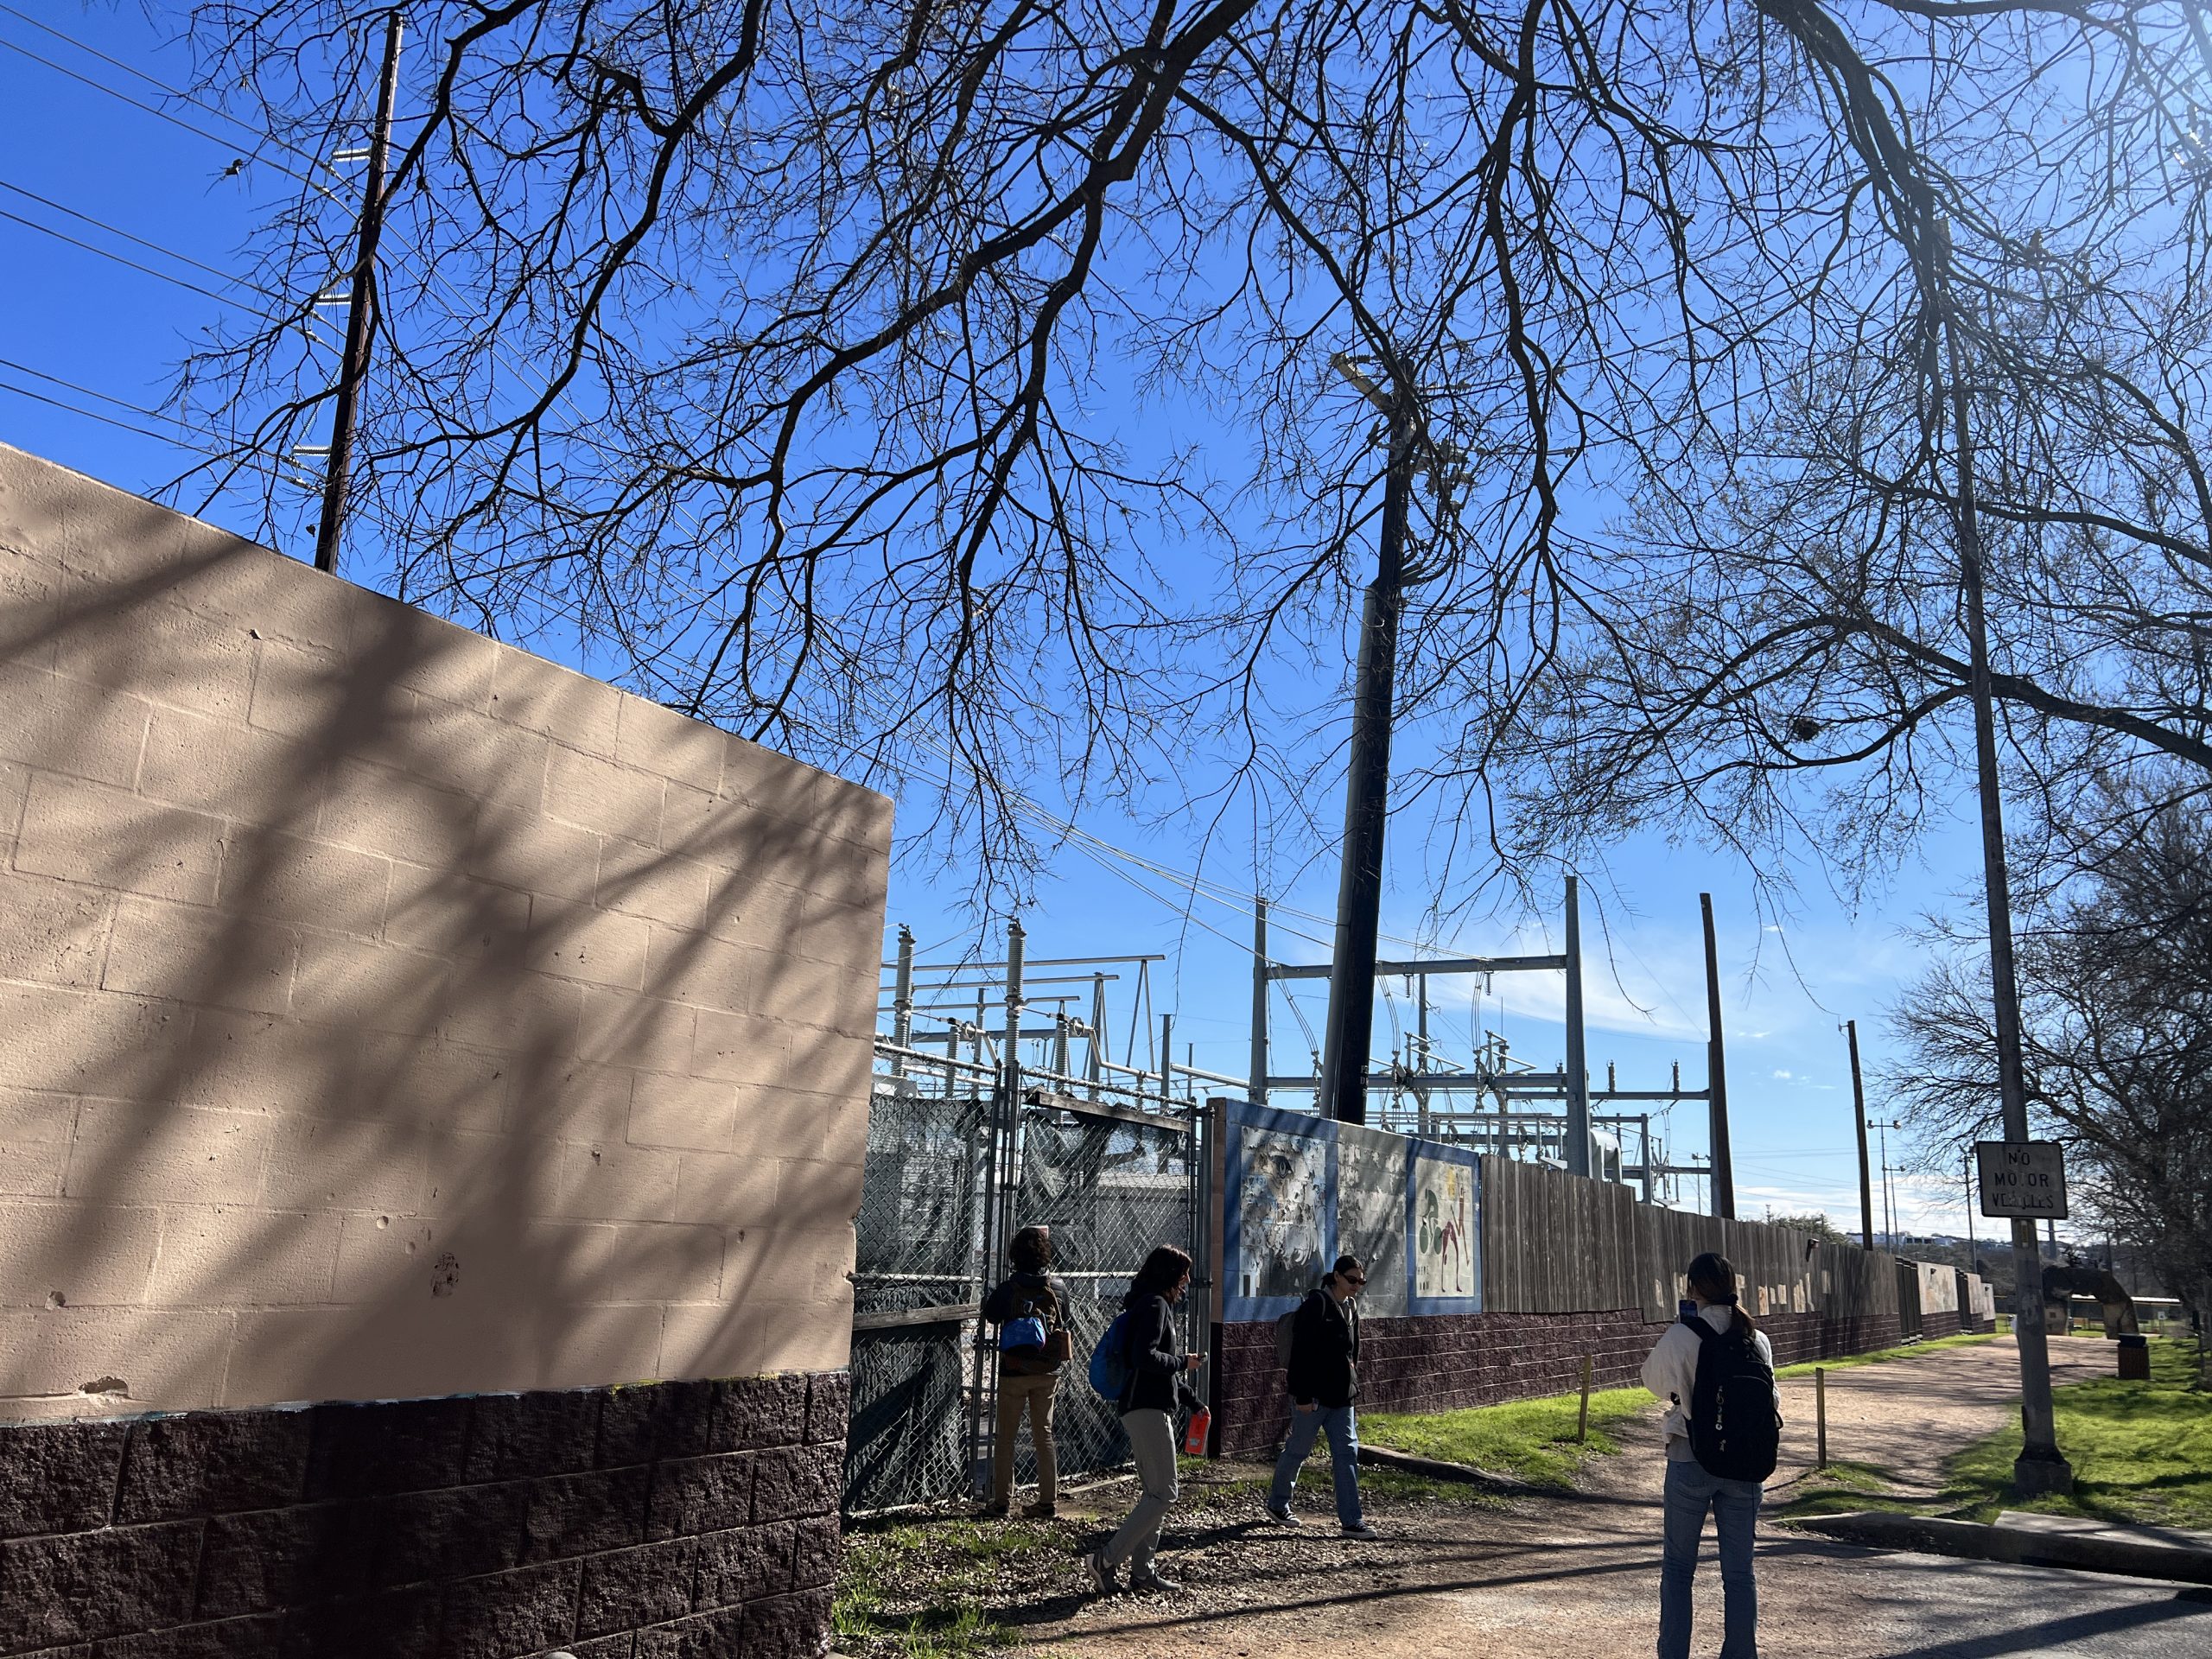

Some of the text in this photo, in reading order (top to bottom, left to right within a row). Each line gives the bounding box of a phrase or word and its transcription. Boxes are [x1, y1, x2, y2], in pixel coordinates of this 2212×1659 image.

[2008, 1152, 2031, 1166] NO
[1994, 1173, 2049, 1187] MOOR
[1993, 1193, 2054, 1210] VECLES
